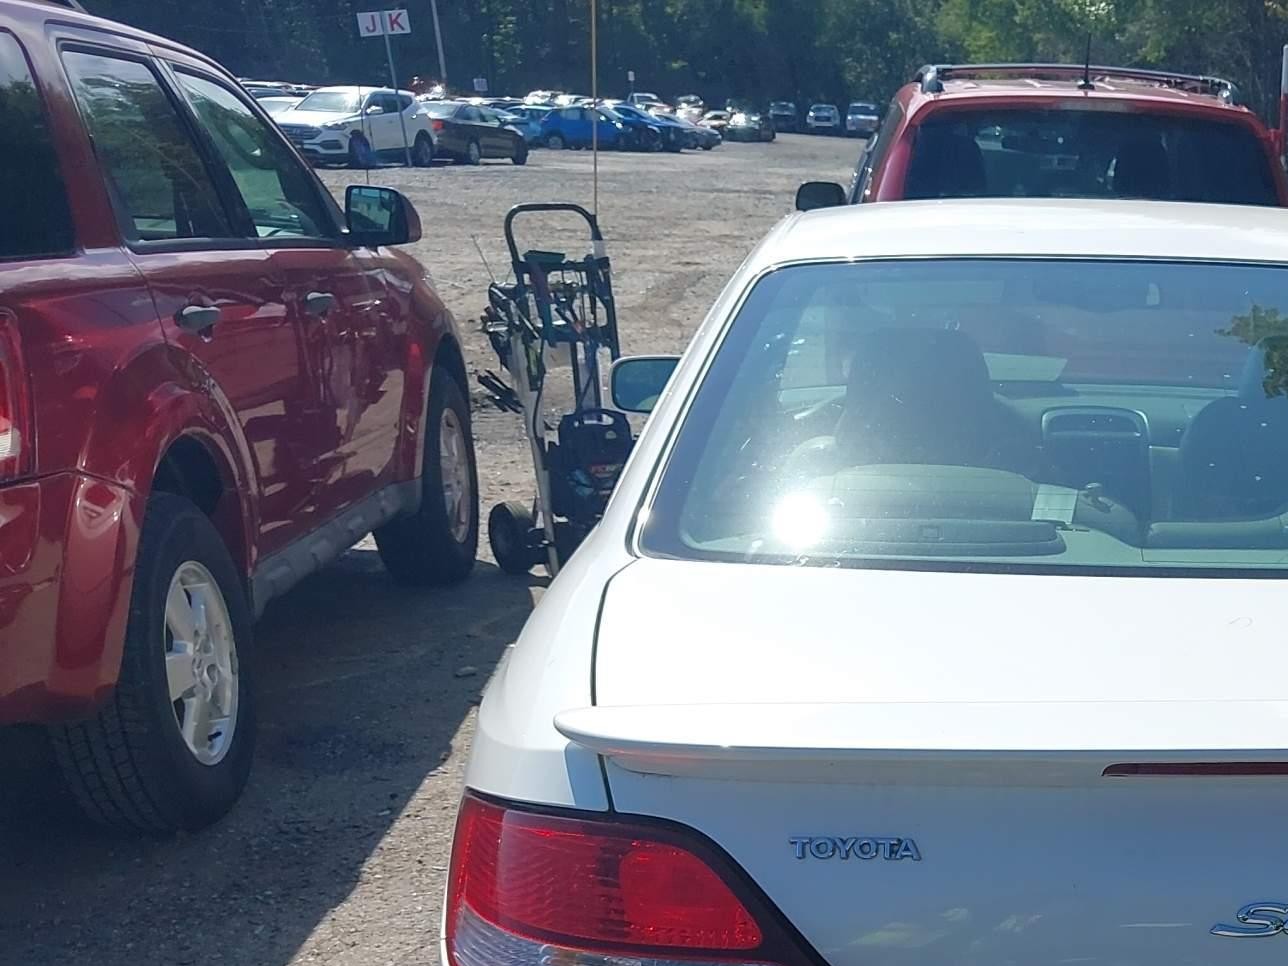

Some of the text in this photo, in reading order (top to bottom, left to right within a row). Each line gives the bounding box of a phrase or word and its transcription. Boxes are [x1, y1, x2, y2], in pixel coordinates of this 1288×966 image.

[366, 13, 405, 33] J K
[789, 837, 922, 861] TOYOTA
